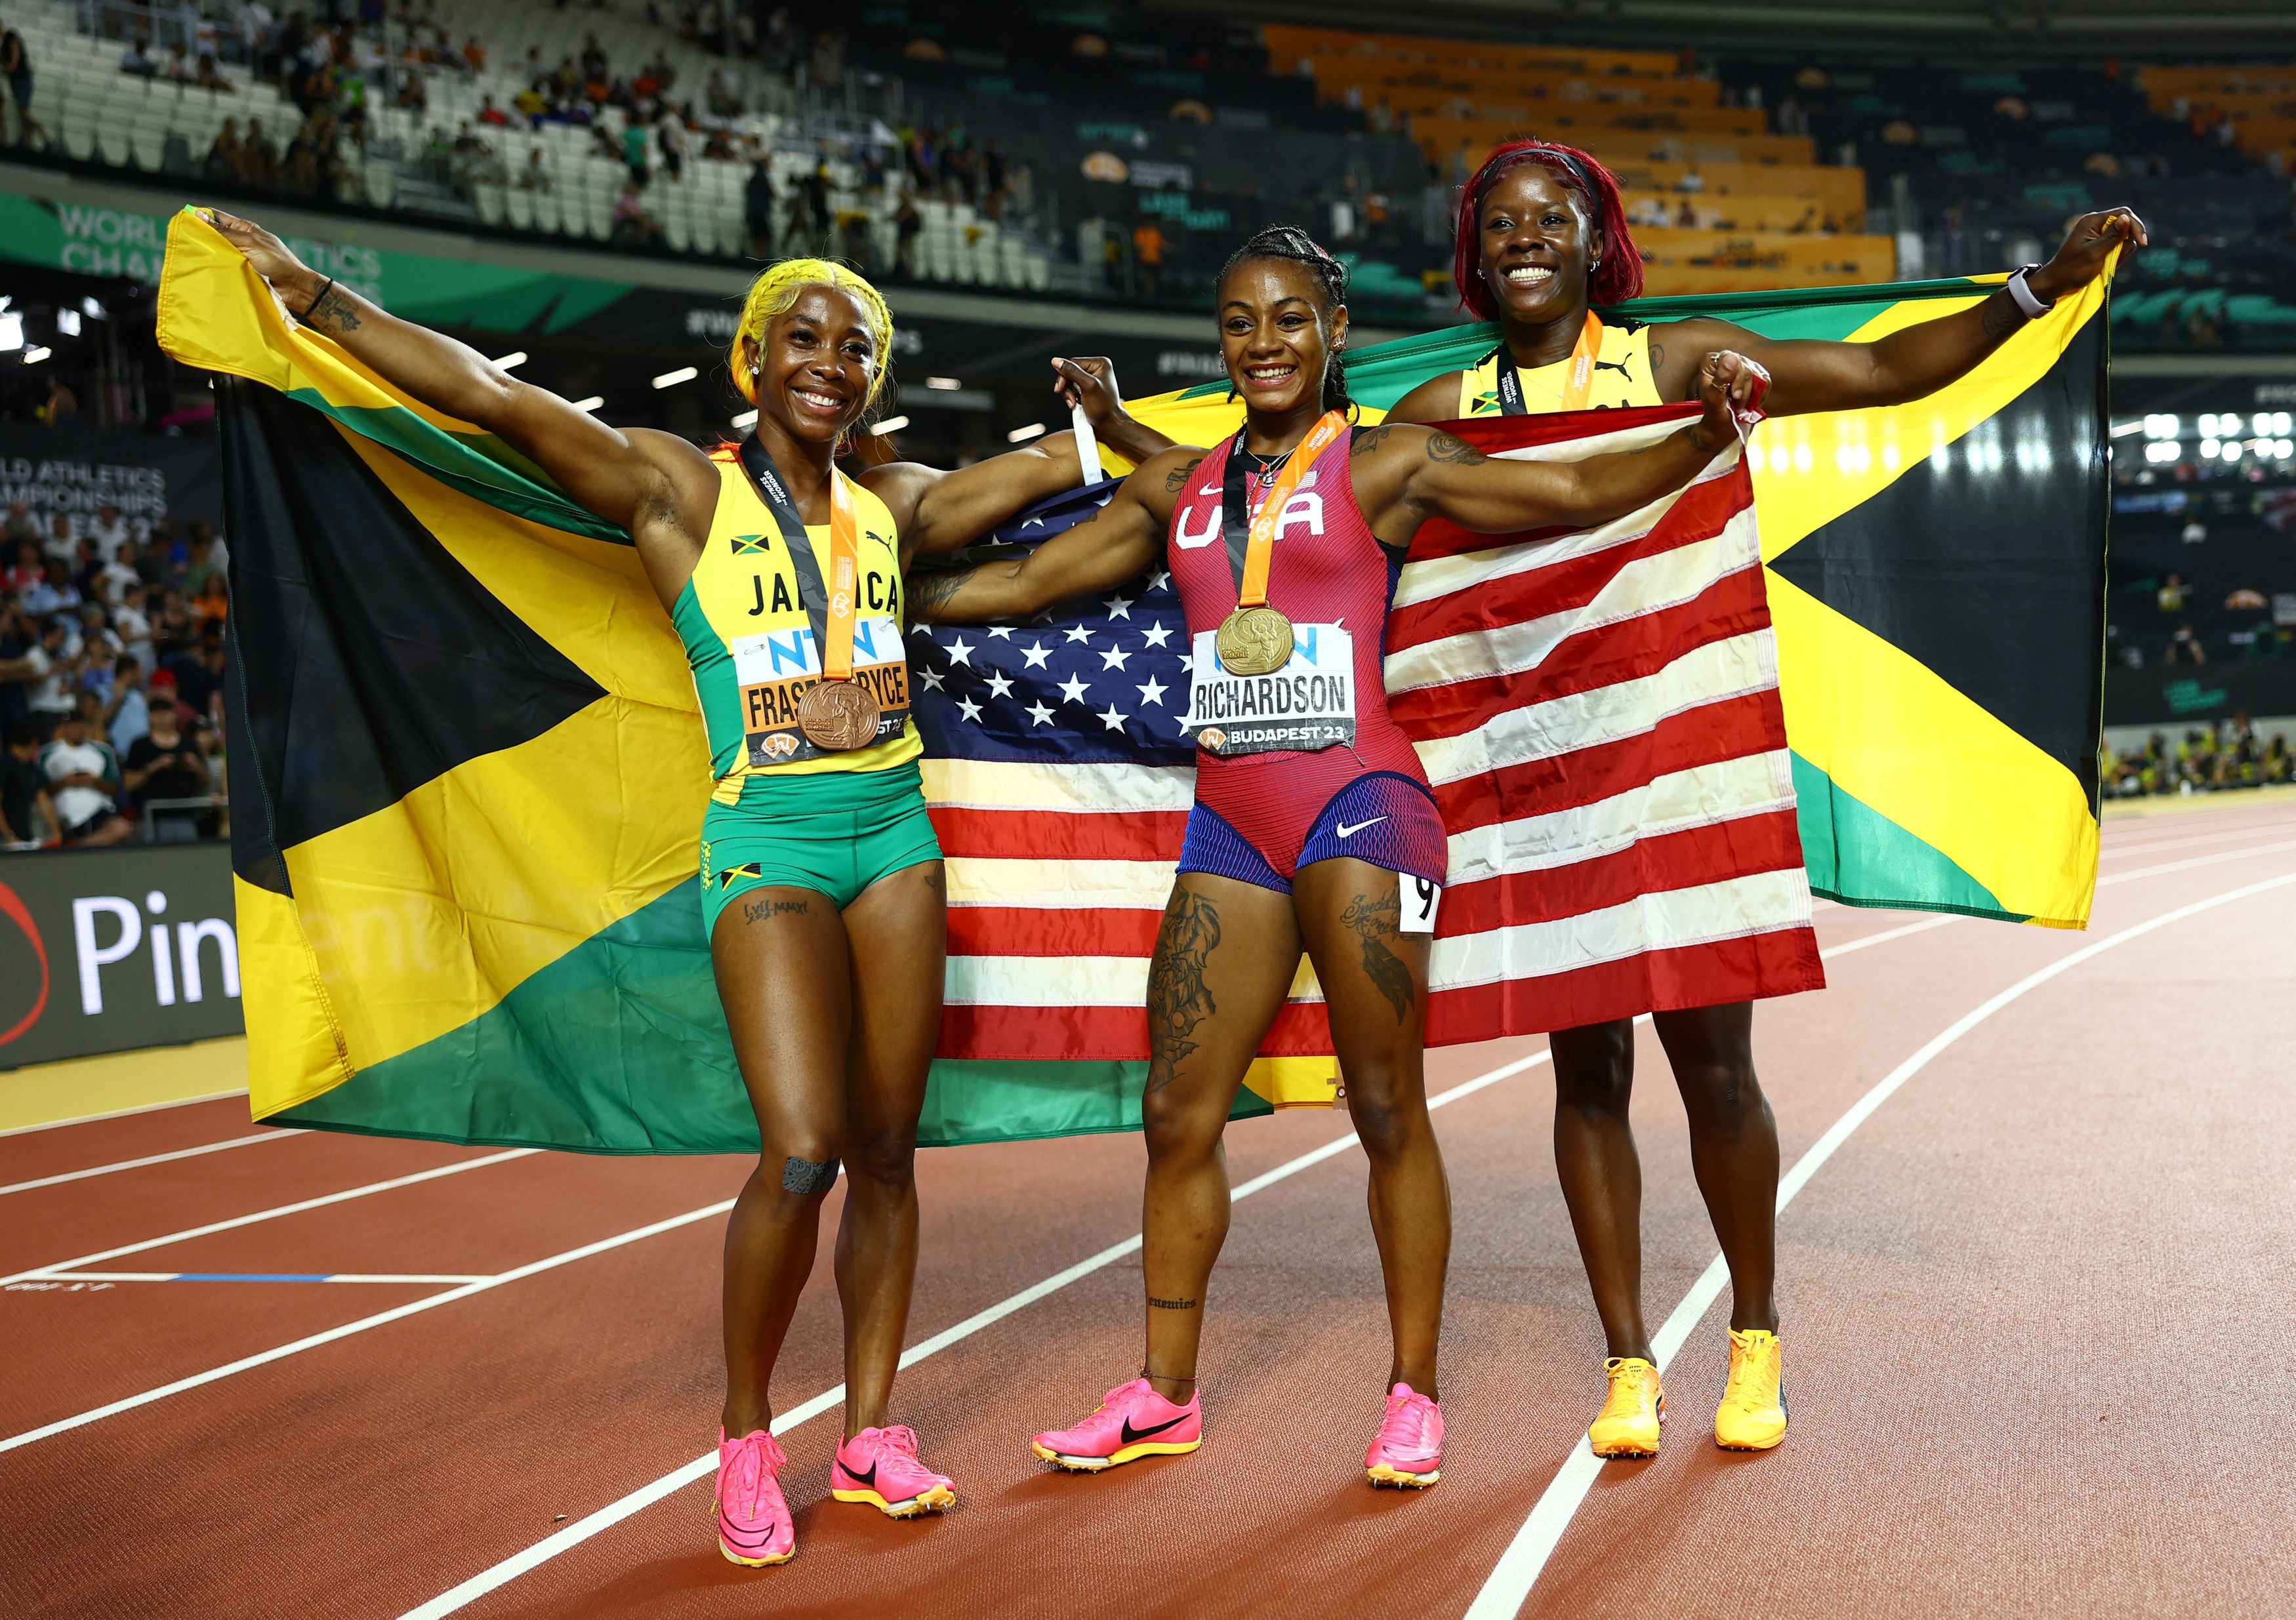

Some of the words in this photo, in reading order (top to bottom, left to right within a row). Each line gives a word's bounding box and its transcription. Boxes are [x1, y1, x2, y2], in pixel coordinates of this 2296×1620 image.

[60, 204, 165, 251] WORL
[1502, 376, 1512, 403] WITNESS
[1507, 370, 1517, 397] WONDER
[760, 476, 782, 504] WITNESS
[764, 470, 786, 498] WONDER
[748, 571, 898, 616] JAICA
[1195, 675, 1345, 720] RICHARDSON
[1231, 727, 1321, 744] BUDAPEST
[1323, 726, 1345, 739] 23
[1416, 876, 1434, 921] 9
[1149, 1297, 1197, 1310] enemies
